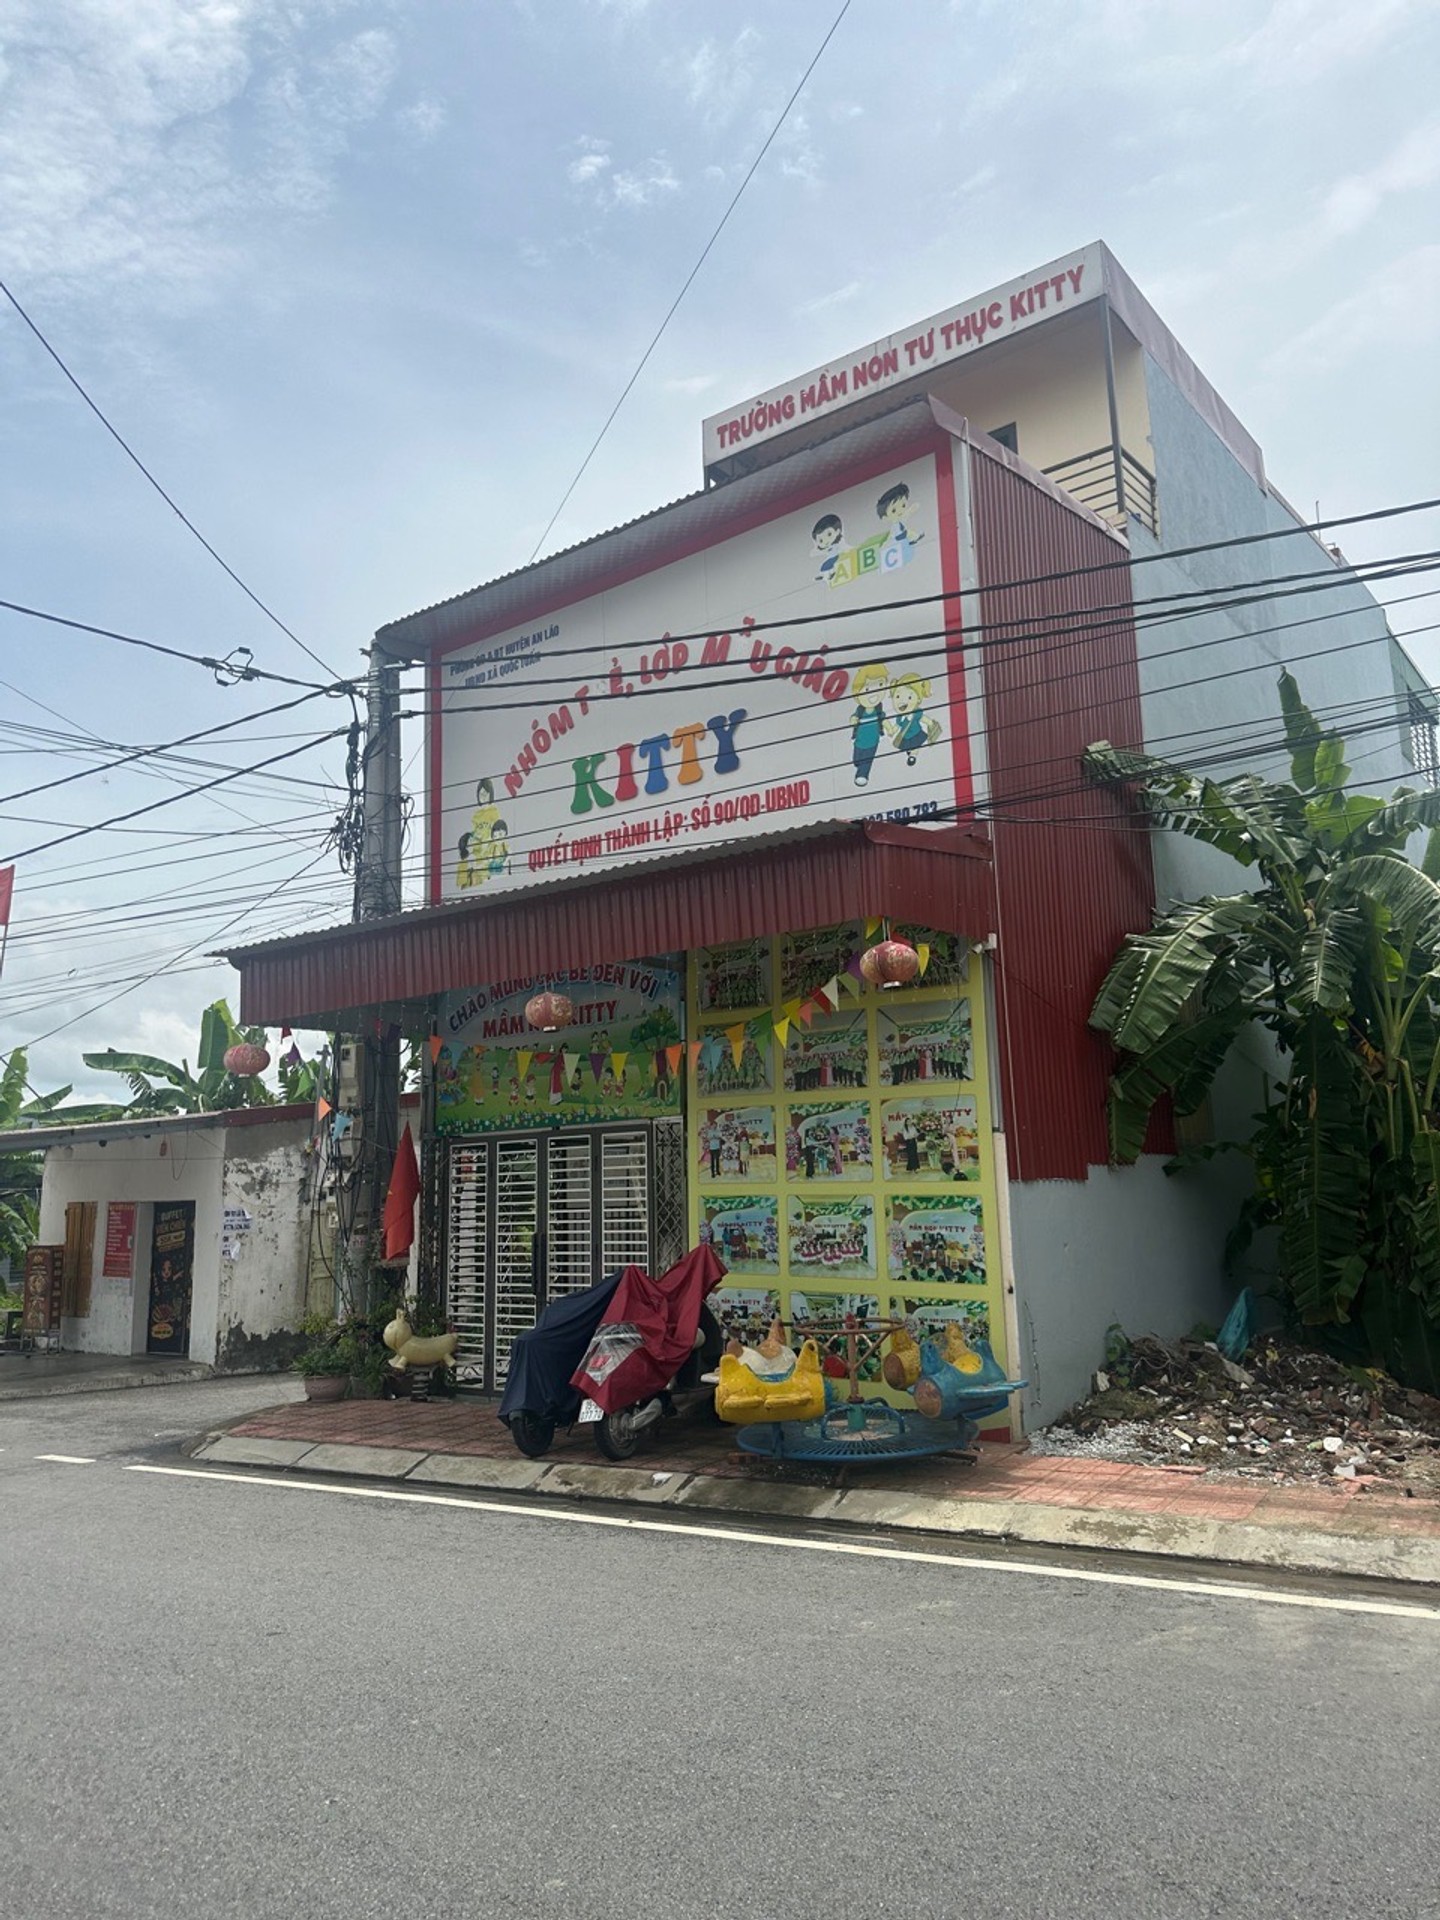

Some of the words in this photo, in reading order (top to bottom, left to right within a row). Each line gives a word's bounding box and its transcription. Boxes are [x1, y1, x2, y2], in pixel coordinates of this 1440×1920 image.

[717, 395, 795, 448] TRƯỜNG
[800, 369, 847, 414] MẦM
[853, 348, 899, 391] NON
[904, 327, 934, 366] TƯ
[941, 302, 1003, 344] THỤC
[1010, 264, 1084, 321] KITTY
[532, 634, 543, 645] AN
[504, 705, 574, 797] NHÓM
[775, 645, 849, 701] GIÁO
[570, 708, 747, 814] KITTY
[528, 832, 569, 871] QUYẾT
[572, 832, 601, 866] ĐỊNH
[605, 820, 651, 854] THÀNH
[691, 794, 711, 831] SỐ
[450, 993, 487, 1032] CHÀO
[630, 969, 658, 998] VỚI
[483, 1008, 524, 1038] MẦM
